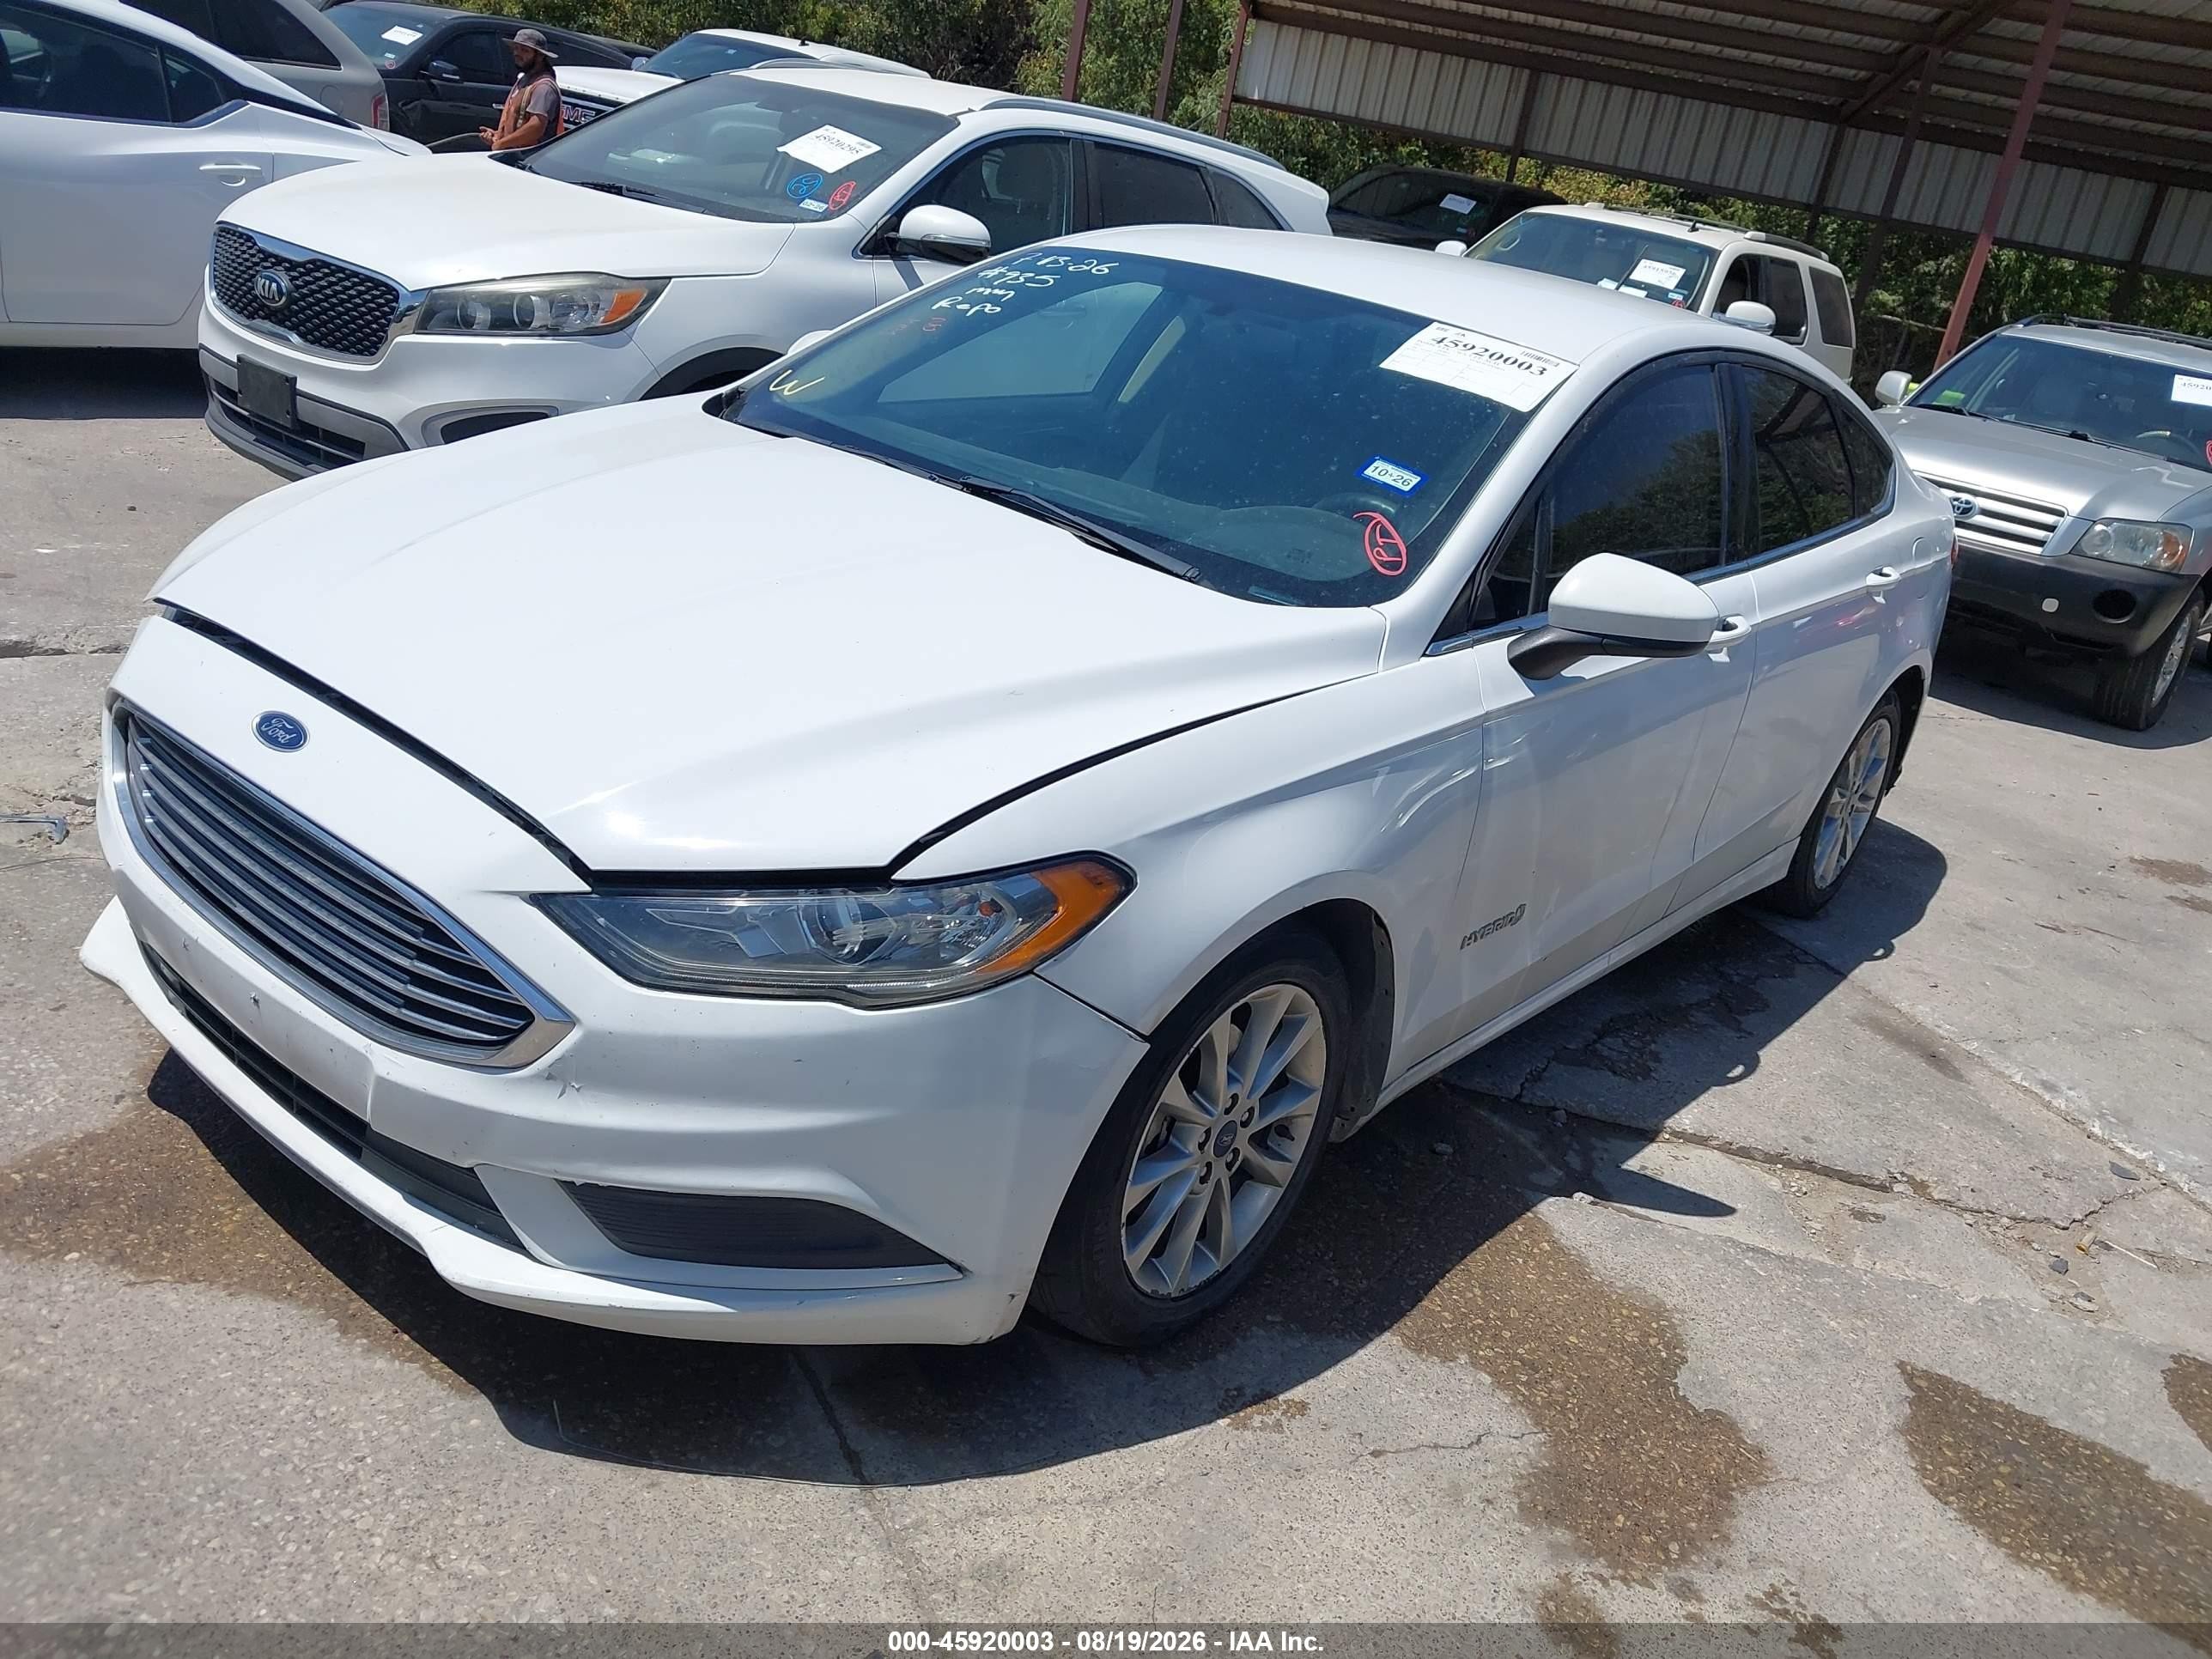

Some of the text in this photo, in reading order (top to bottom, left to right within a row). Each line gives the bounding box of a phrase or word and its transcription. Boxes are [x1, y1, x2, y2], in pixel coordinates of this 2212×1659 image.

[257, 276, 280, 301] KIA
[977, 266, 1061, 288] #935
[931, 296, 1002, 317] Repo
[1431, 337, 1547, 376] 45920003
[260, 718, 297, 744] Ford
[1460, 903, 1527, 951] HYBRID
